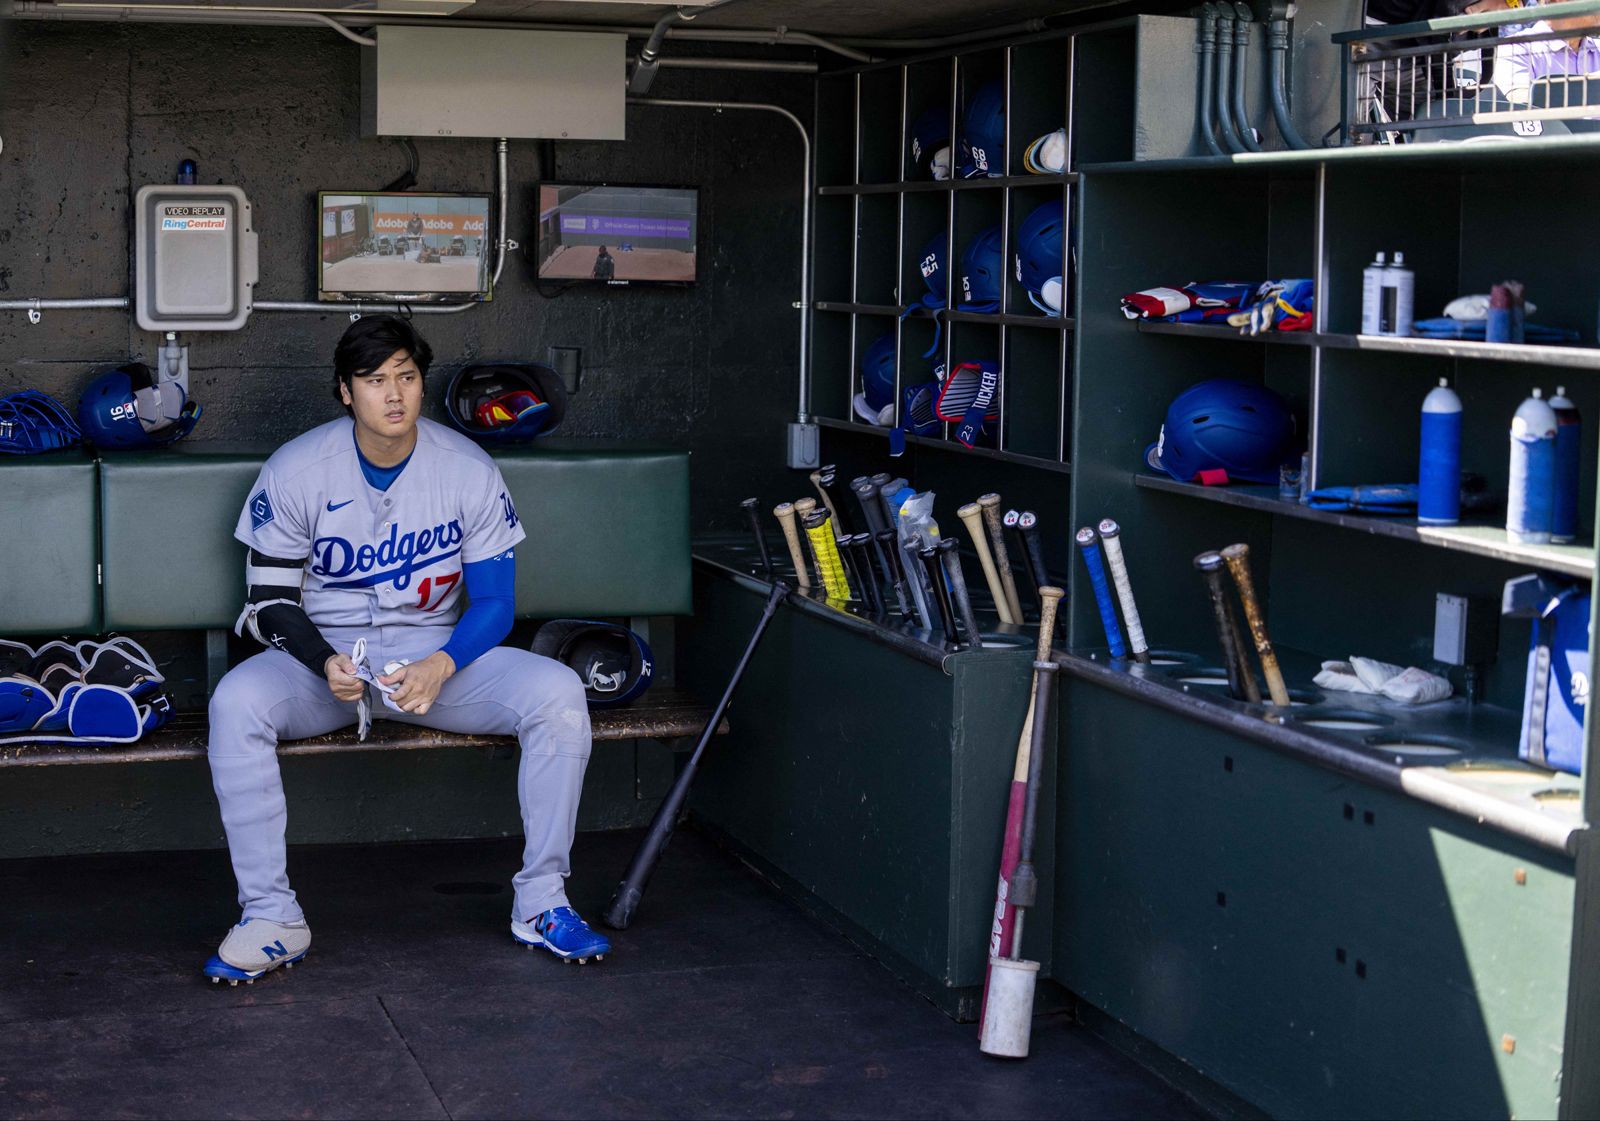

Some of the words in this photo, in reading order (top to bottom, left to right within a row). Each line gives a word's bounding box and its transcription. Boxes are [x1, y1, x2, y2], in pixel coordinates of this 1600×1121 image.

[972, 146, 986, 162] 68
[167, 207, 189, 215] VIDEO
[192, 207, 223, 215] REPLAY
[163, 219, 225, 230] RingCentral
[463, 220, 486, 231] Ado
[925, 253, 939, 274] 25
[971, 371, 998, 409] TUCKER
[110, 405, 125, 421] 16
[961, 424, 974, 441] 23
[311, 518, 464, 591] Dodgers
[416, 570, 462, 613] 17
